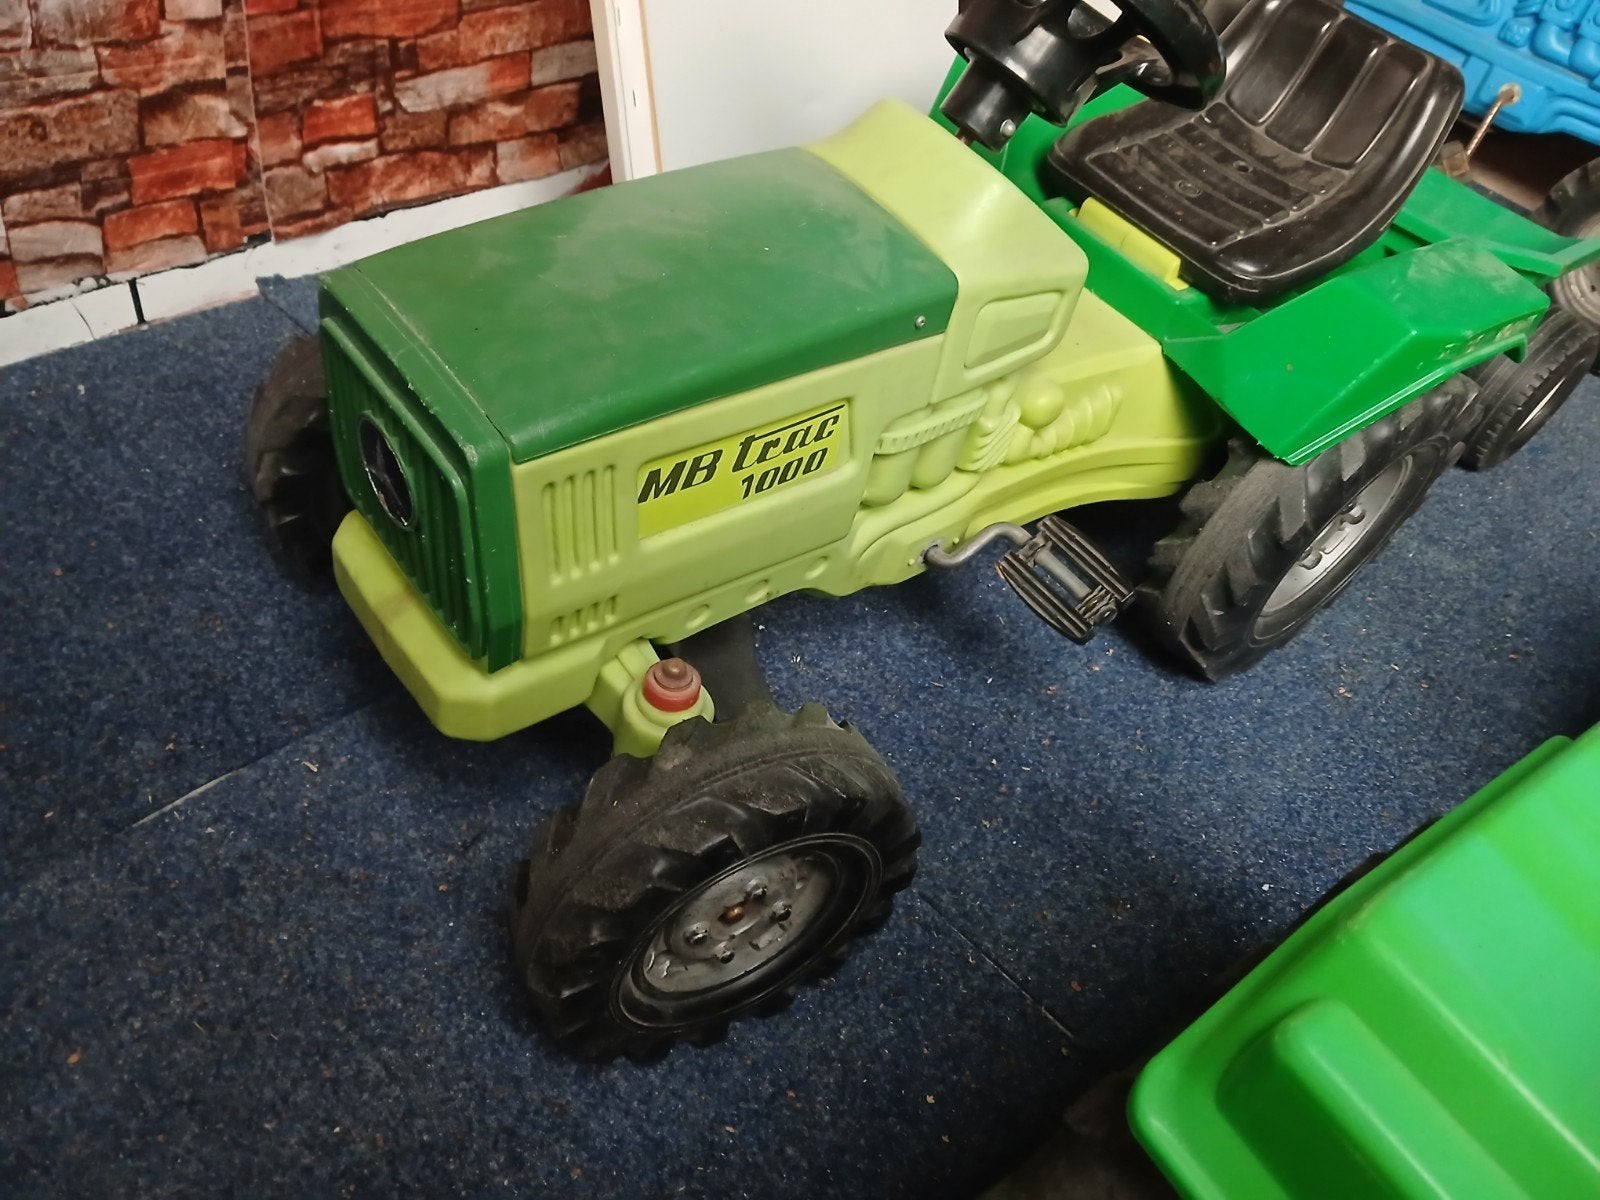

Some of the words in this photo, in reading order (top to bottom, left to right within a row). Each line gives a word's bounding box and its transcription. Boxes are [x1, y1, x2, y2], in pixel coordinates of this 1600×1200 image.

[637, 449, 723, 504] MB
[731, 404, 845, 473] trac
[741, 447, 829, 500] 1000
